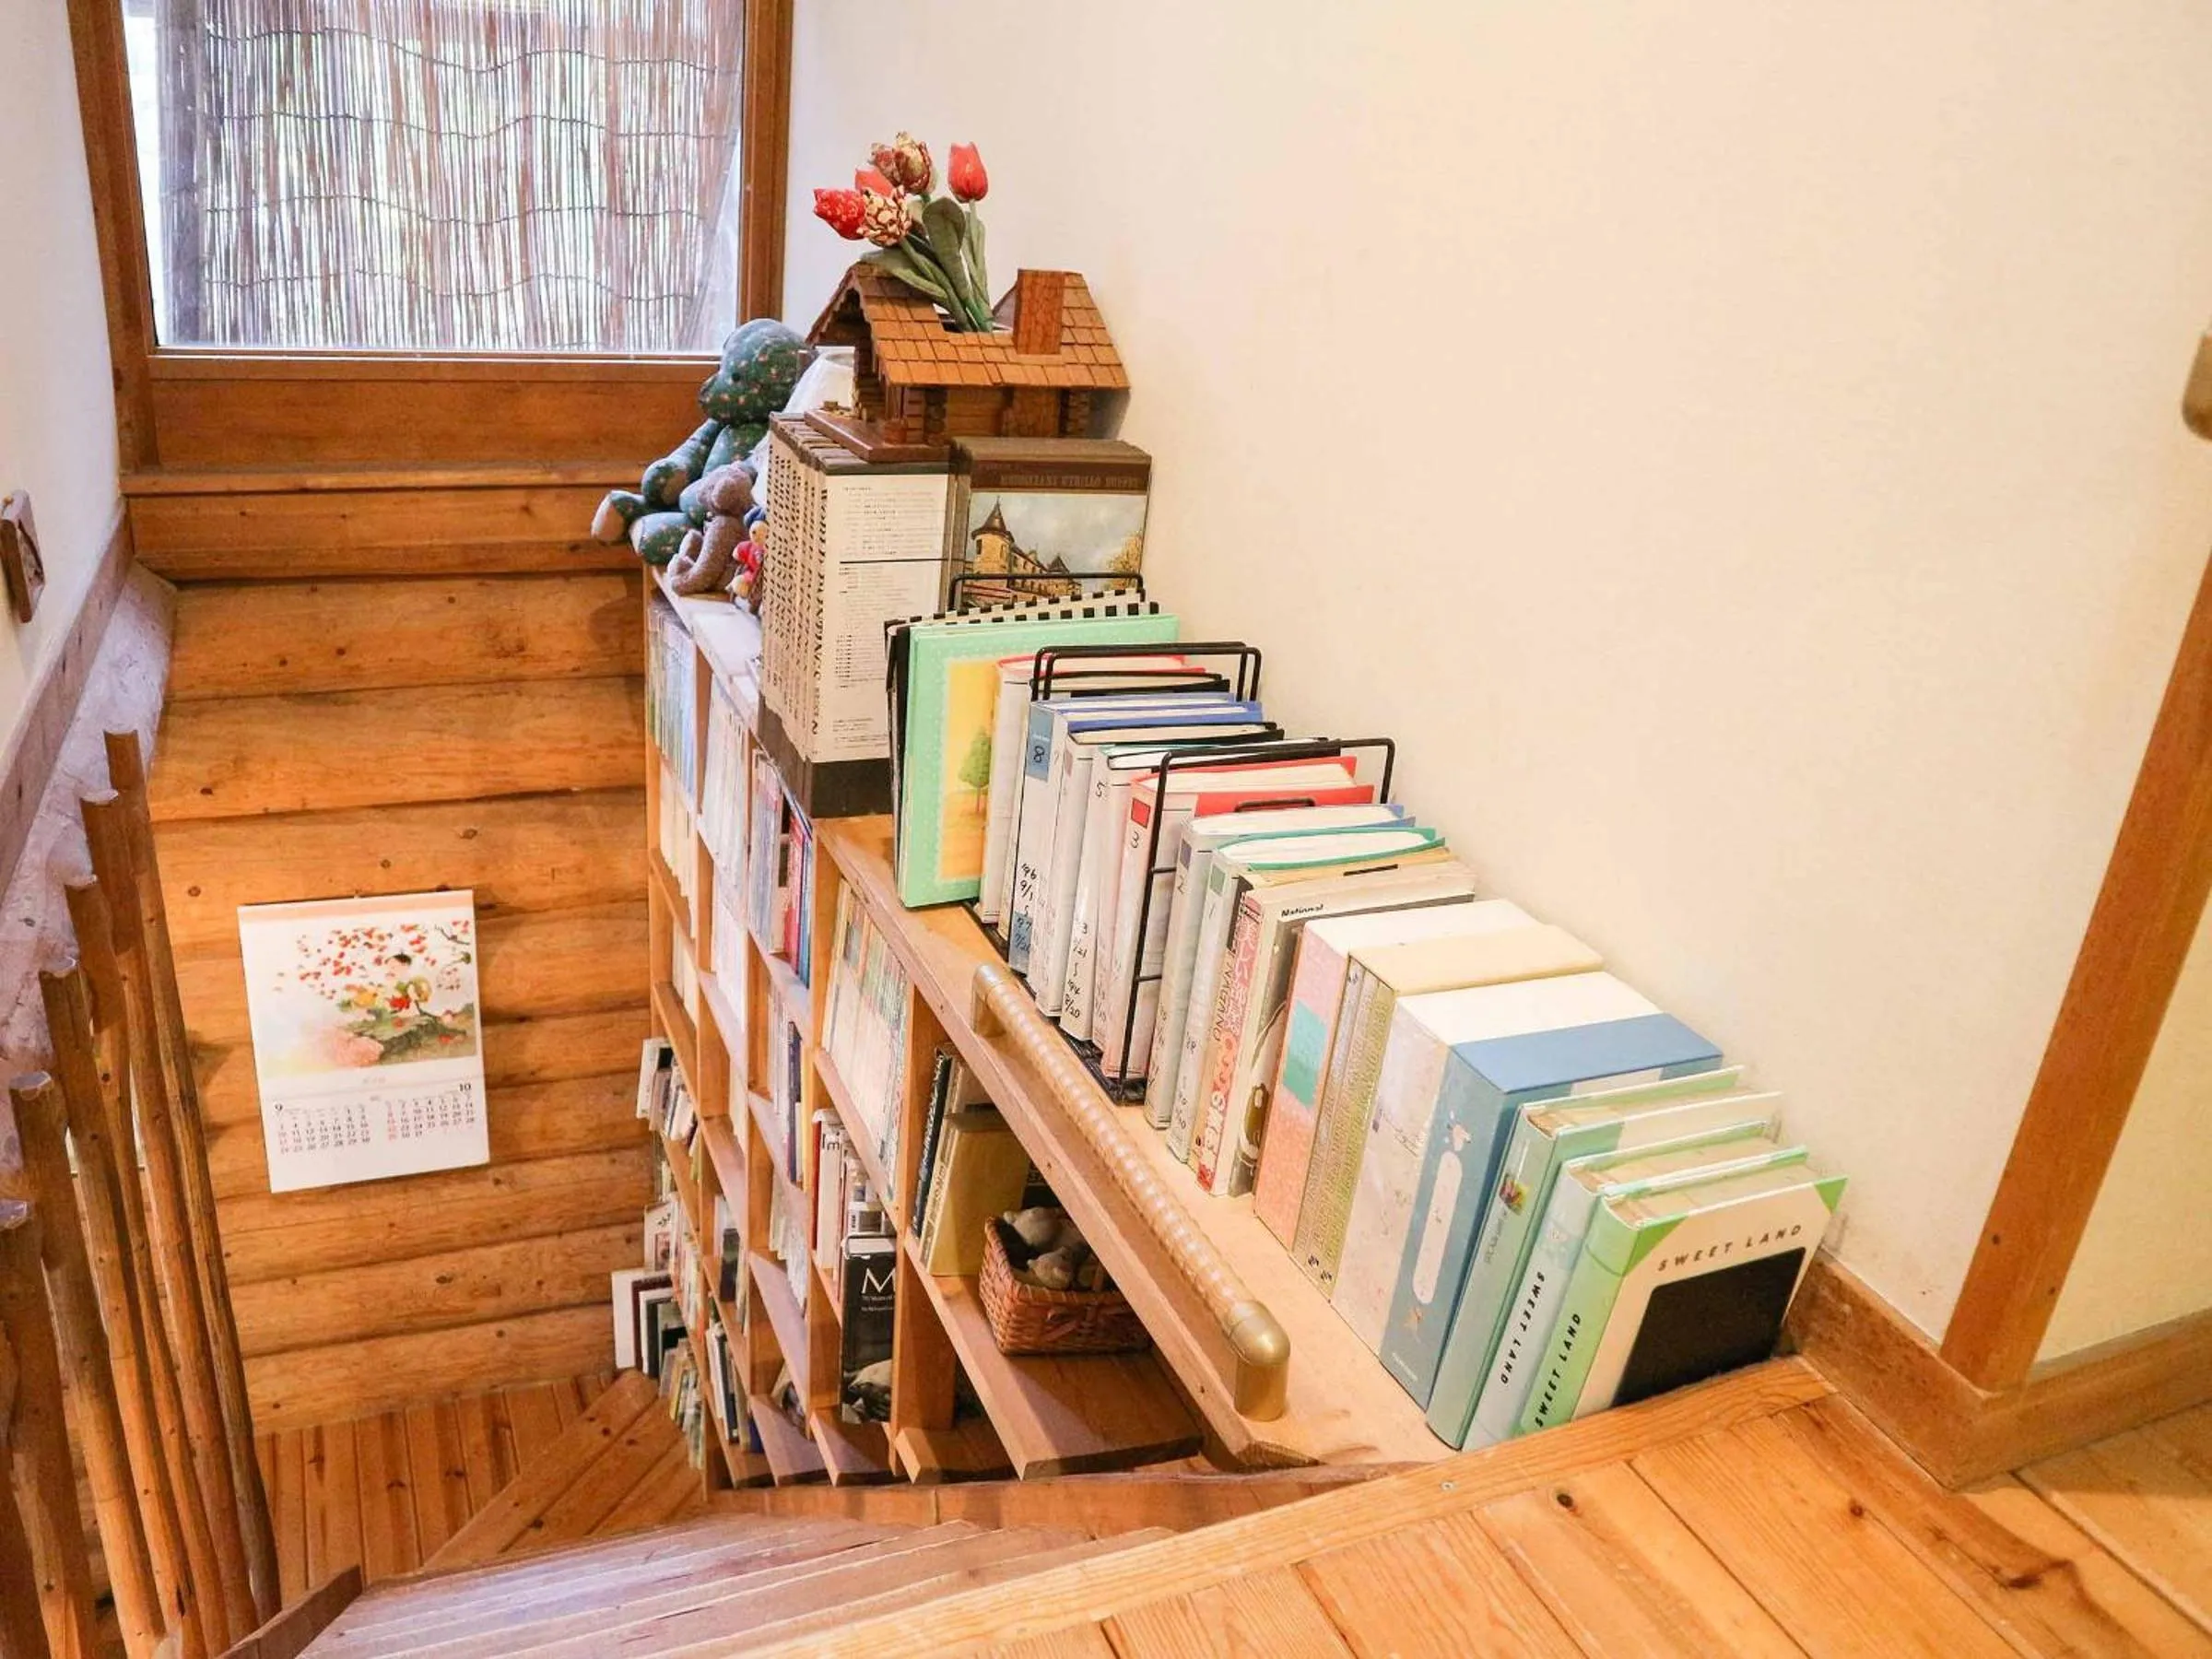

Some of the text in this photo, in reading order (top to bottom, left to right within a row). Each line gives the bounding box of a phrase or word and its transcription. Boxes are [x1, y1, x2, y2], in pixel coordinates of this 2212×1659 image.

[1033, 745, 1045, 763] 8
[1130, 831, 1140, 849] 3
[1281, 903, 1324, 917] National
[460, 1083, 471, 1091] 10
[1658, 1225, 1802, 1271] SWEET LAND
[1500, 1271, 1545, 1384] SWEET LAND
[1535, 1313, 1581, 1428] SWEET LAND
